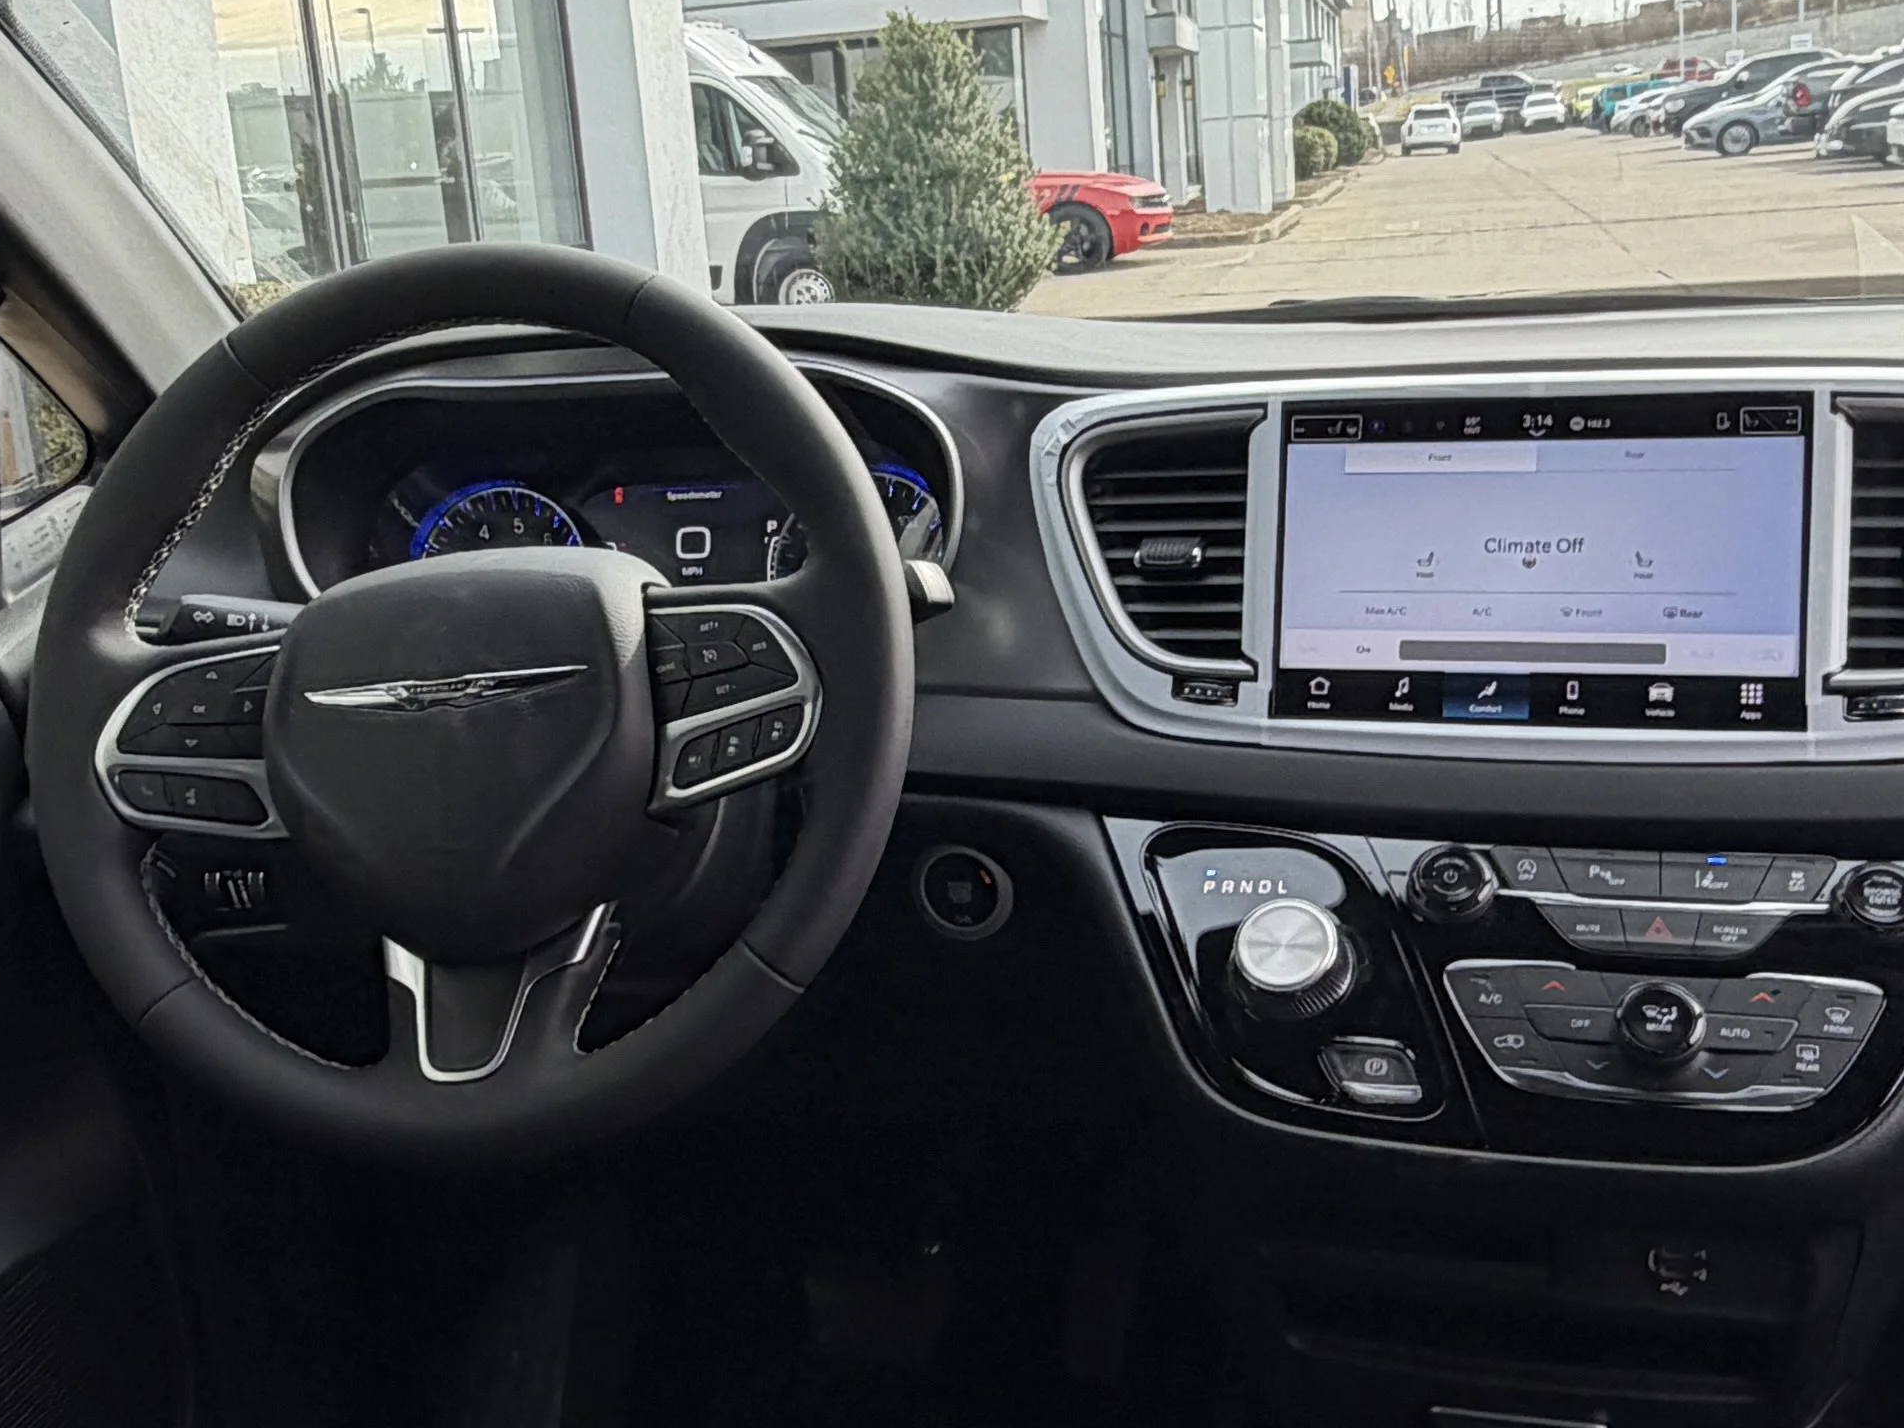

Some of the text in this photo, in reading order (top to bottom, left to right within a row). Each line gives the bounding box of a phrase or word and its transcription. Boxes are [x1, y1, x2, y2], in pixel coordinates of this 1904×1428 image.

[1523, 414, 1553, 428] 3:14
[479, 524, 490, 540] 4
[513, 517, 525, 535] 5
[1484, 537, 1584, 554] Climate Off
[1469, 704, 1502, 714] Comfort
[1559, 706, 1585, 716] Phone
[1740, 710, 1762, 721] Apps
[1478, 993, 1503, 1005] A/C
[1720, 1027, 1751, 1039] AUTO
